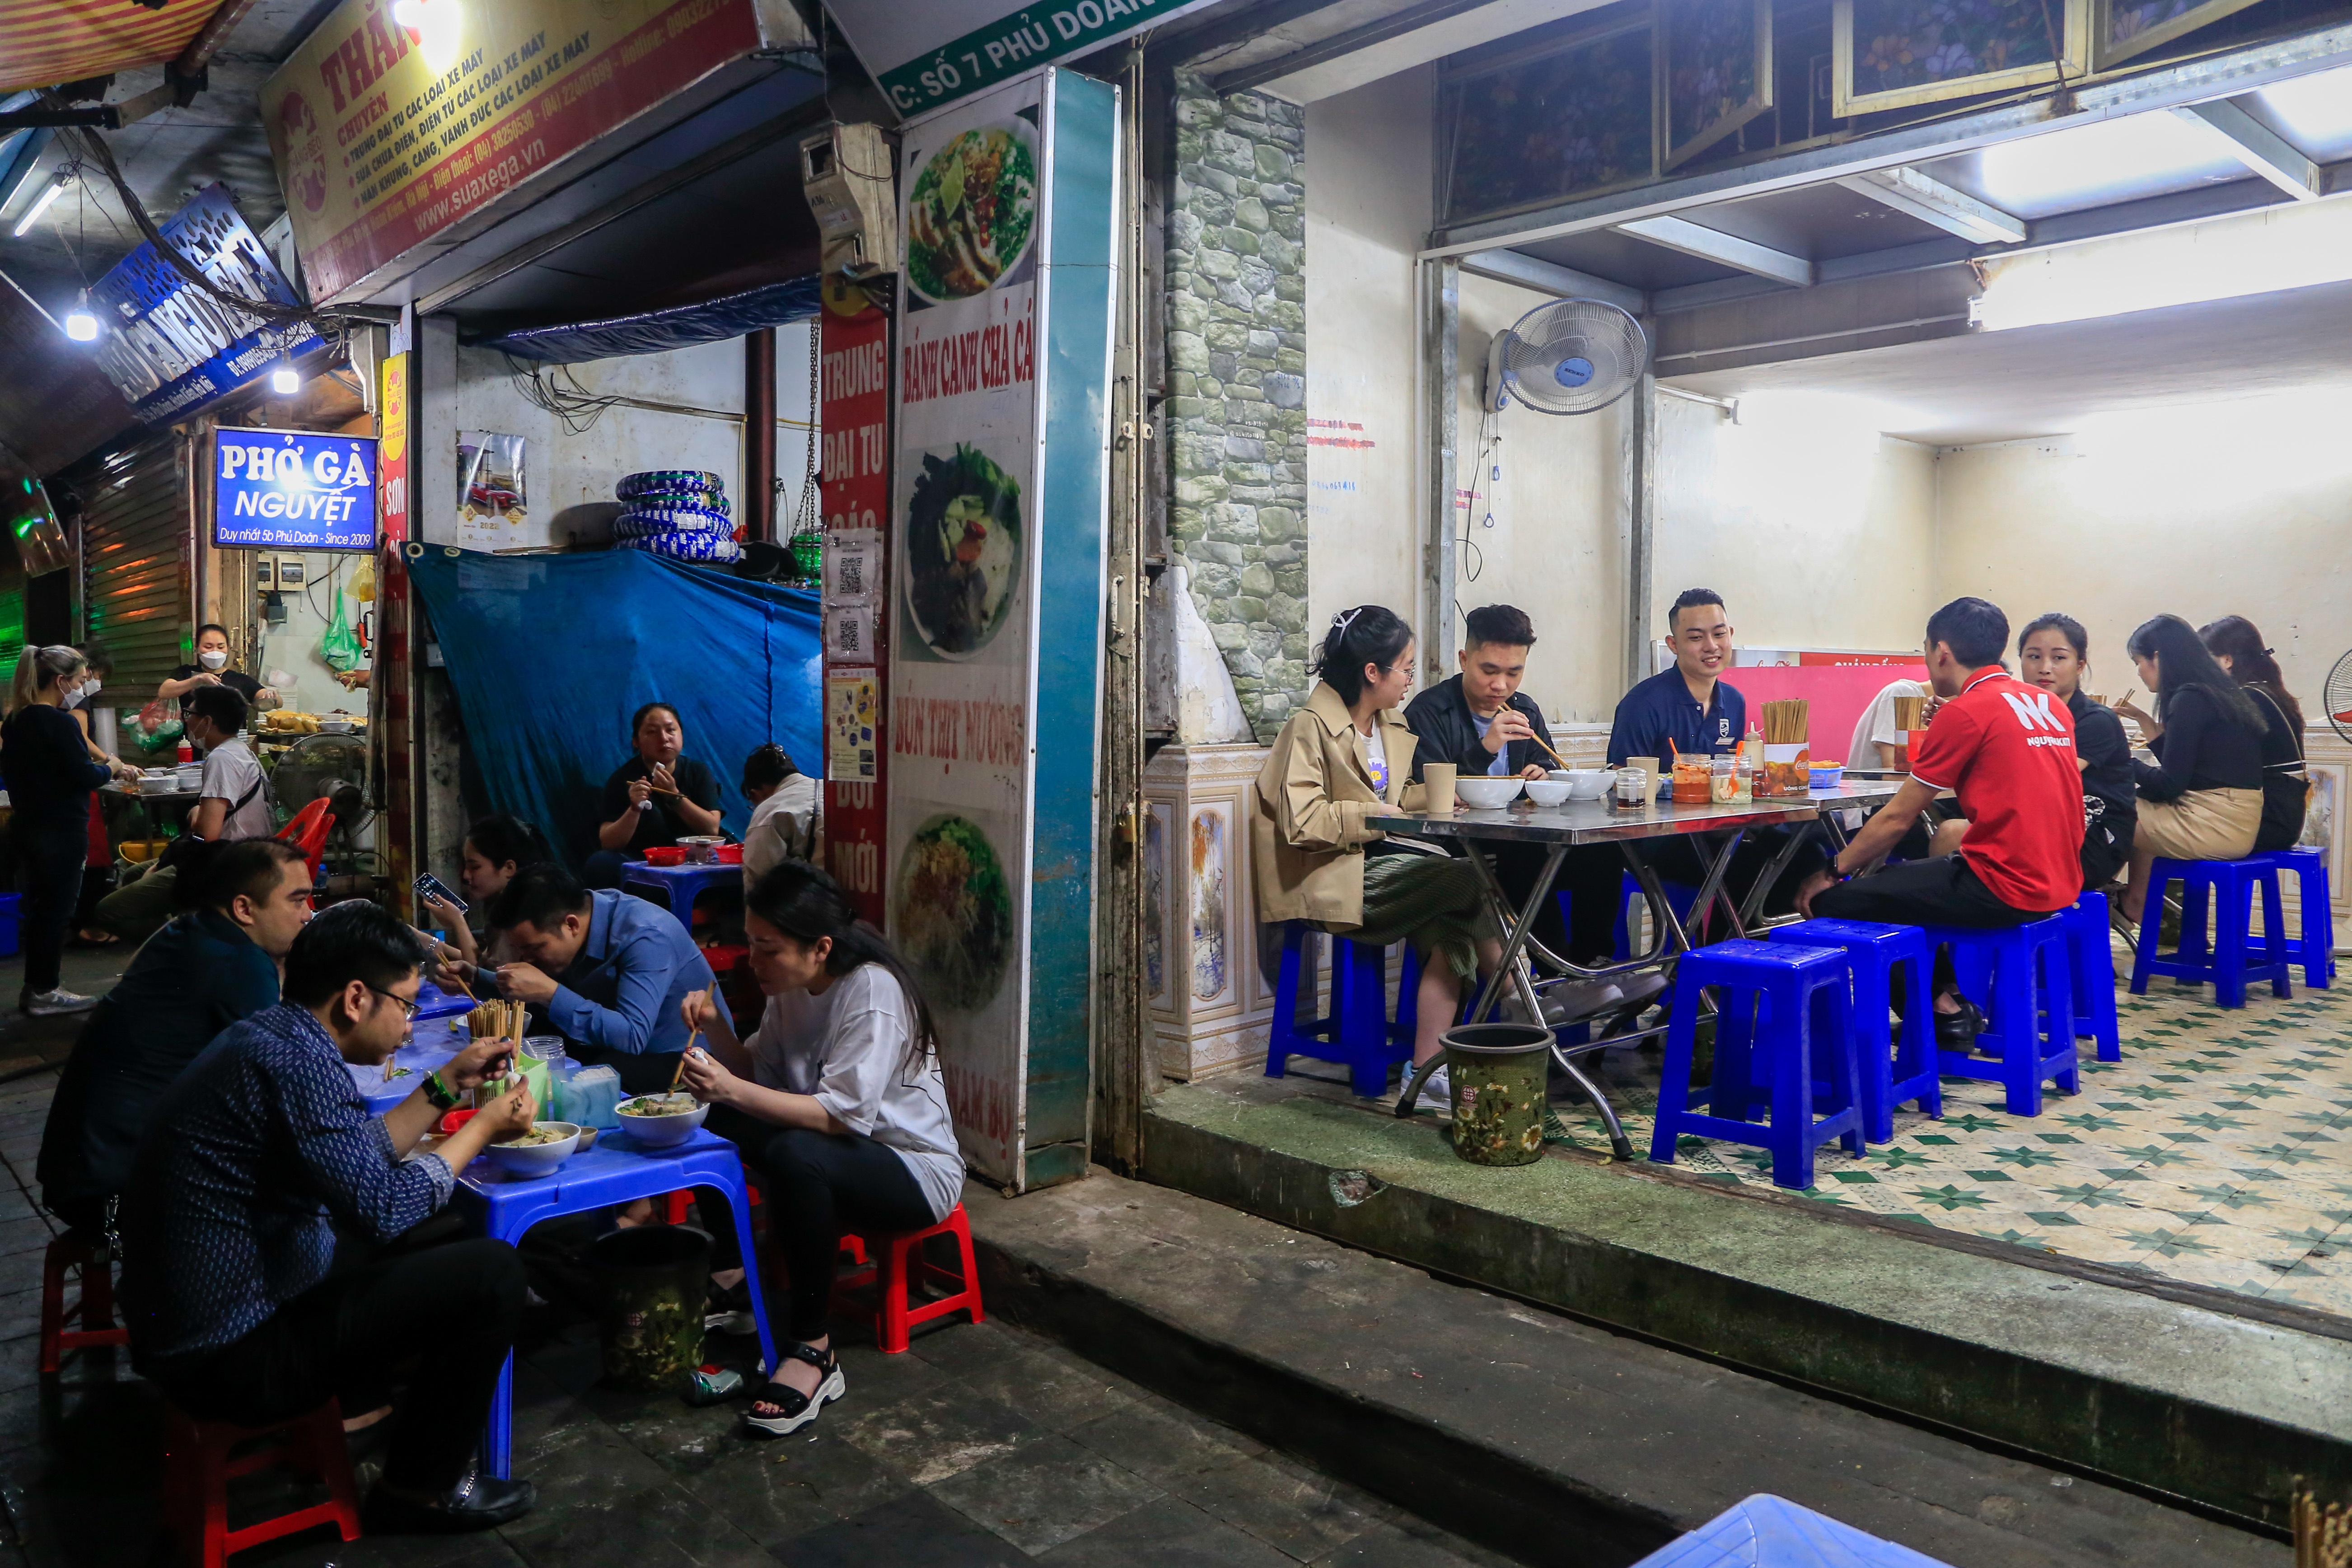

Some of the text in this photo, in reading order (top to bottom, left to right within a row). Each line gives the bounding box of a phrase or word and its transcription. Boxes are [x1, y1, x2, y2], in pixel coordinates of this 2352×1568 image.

[920, 48, 962, 97] SỐ
[962, 52, 982, 78] 7
[985, 13, 1051, 70] PHỦ
[337, 91, 389, 147] CHUYÊN
[350, 47, 483, 163] TRUNG ĐẠI TU CÁC LOẠI XE MÁY
[394, 129, 419, 155] ĐIỆN,
[419, 110, 442, 137] ĐIỆN
[442, 96, 455, 119] TỬ
[457, 84, 476, 108] CÁC
[477, 64, 503, 94] LOẠI
[504, 51, 519, 75] XE
[521, 30, 545, 62] MÁY
[412, 141, 440, 168] CÀNG,
[440, 118, 469, 147] VÀNH
[470, 101, 492, 127] ĐÚC
[494, 85, 514, 110] CÁC
[515, 65, 543, 95] LOẠI
[544, 52, 561, 76] XE
[563, 29, 589, 63] MÁY
[433, 167, 452, 190] Điện
[451, 150, 474, 175] thoại:
[473, 138, 492, 165] (04)
[491, 109, 535, 151] 38250530
[415, 138, 546, 233] www.suaxega.vn
[823, 340, 884, 402] TRUNG
[904, 297, 1033, 403] BÁNH CANH CHẢ CÁ
[221, 435, 371, 489] PHỞ GÀ
[824, 423, 883, 491] ĐẠI TU
[234, 488, 356, 526] NGUYỆT
[386, 476, 404, 516] SƠN
[220, 528, 370, 545] Duy nhất 5b Phủ Doãn Since 2009
[834, 829, 877, 894] MỚI
